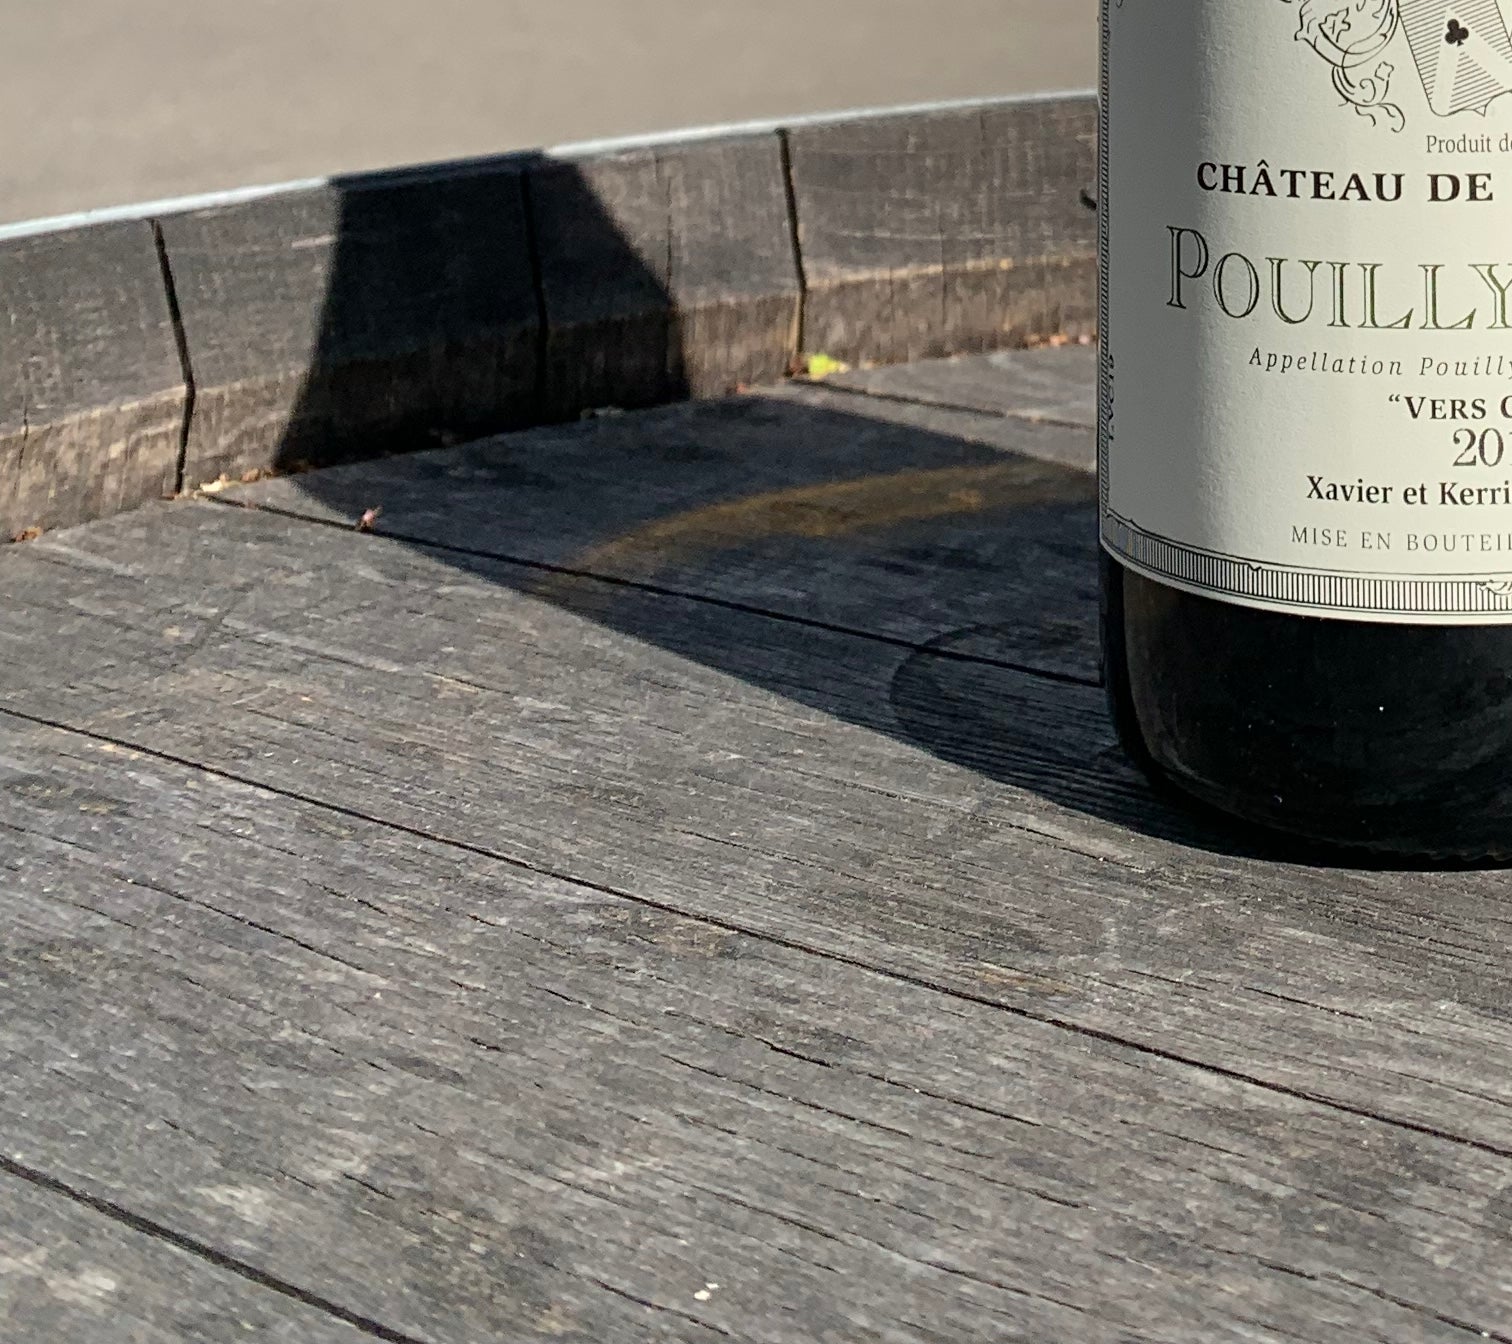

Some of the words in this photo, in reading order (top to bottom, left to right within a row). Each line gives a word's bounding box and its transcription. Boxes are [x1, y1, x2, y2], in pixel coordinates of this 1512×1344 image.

[1426, 134, 1491, 153] Produit
[1197, 159, 1405, 202] CHÂTEAU
[1427, 172, 1494, 202] DE
[1249, 346, 1402, 377] Appellation
[1306, 475, 1394, 505] Xavier
[1402, 479, 1428, 506] et
[1291, 525, 1348, 549] MISE
[1361, 531, 1391, 551] EN
